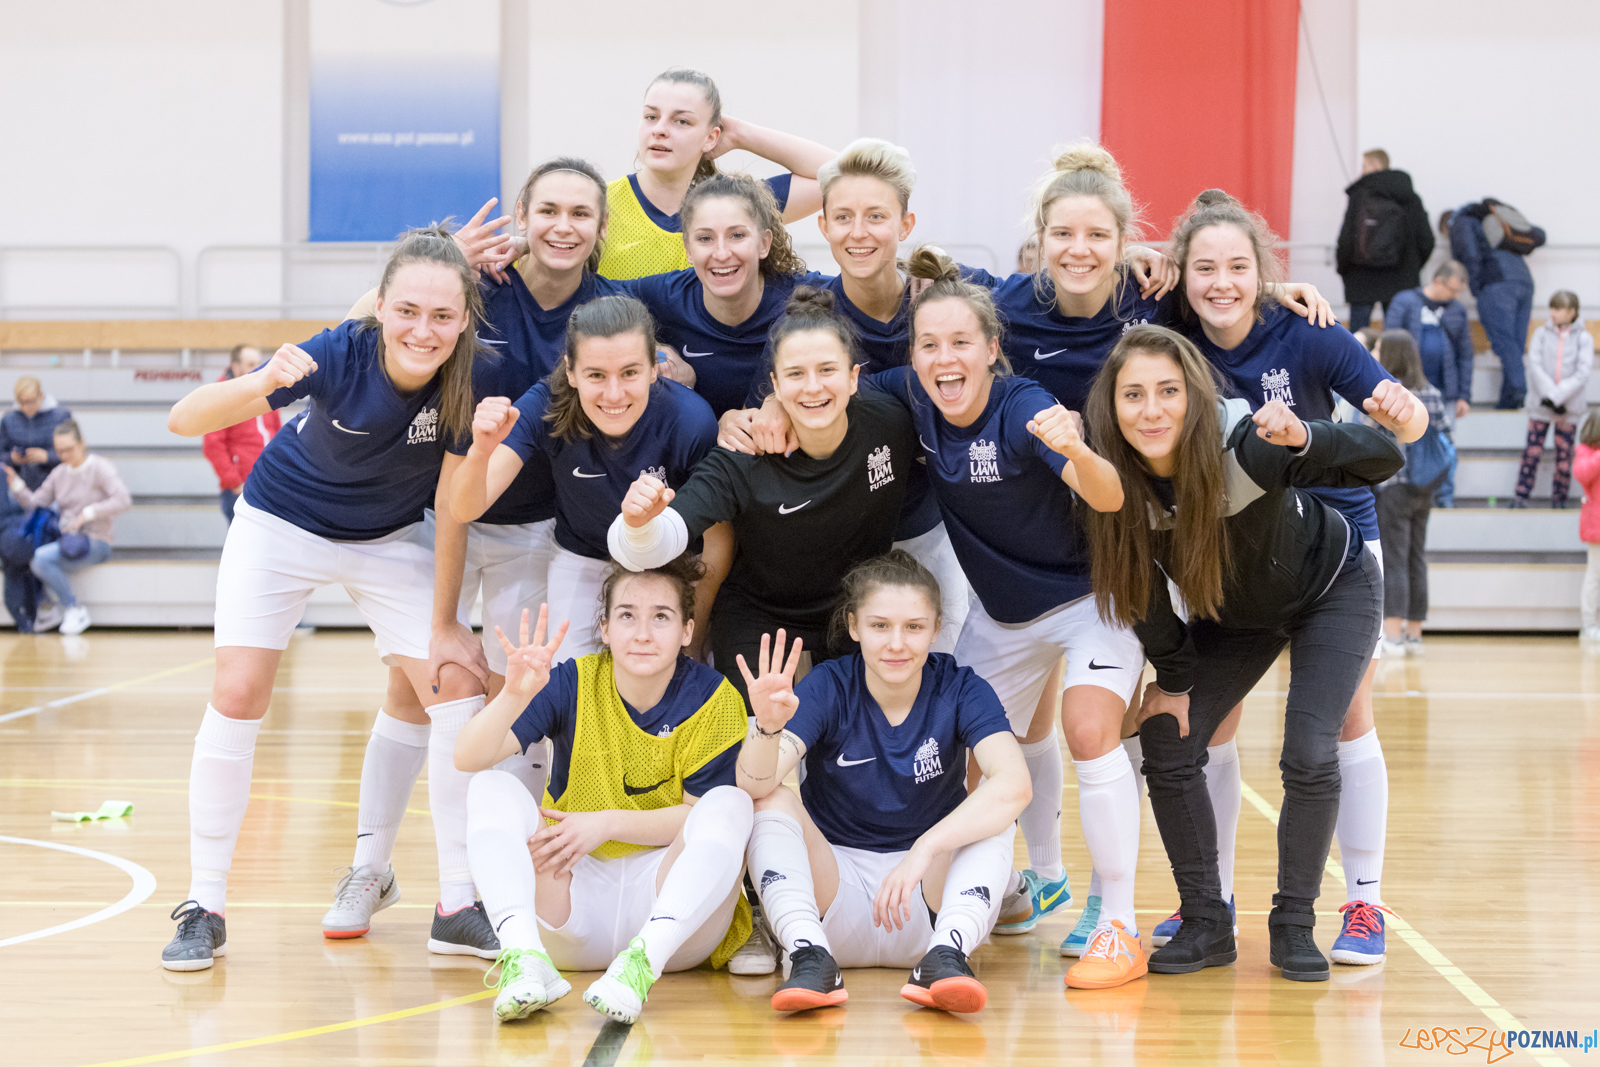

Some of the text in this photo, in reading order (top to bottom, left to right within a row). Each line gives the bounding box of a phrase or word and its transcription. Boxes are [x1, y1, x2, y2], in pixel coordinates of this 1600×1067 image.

[408, 425, 437, 439] UAM
[406, 436, 437, 445] FUTSAL
[868, 461, 893, 484] UAM
[970, 461, 999, 476] UAM
[870, 474, 896, 492] FUTSAL
[970, 475, 1003, 483] FUTSAL
[913, 756, 942, 776] UAM
[915, 768, 945, 784] FUTSAL
